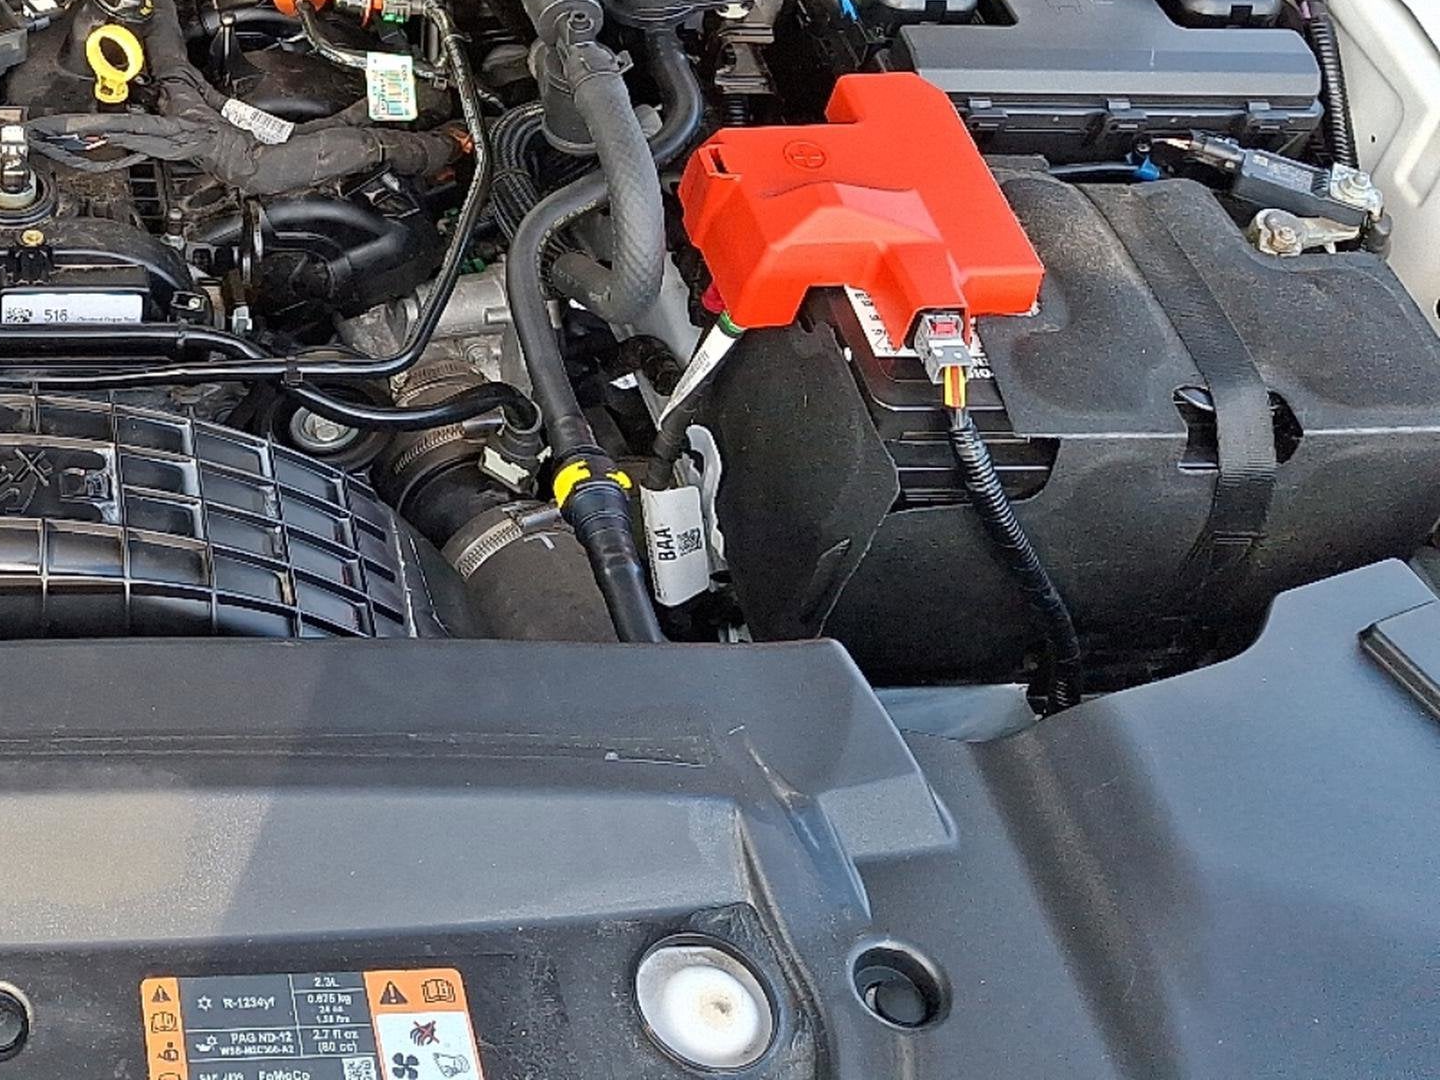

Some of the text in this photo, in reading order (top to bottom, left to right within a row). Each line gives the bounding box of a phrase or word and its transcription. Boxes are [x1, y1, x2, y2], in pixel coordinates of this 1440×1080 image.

[44, 308, 67, 322] 516
[654, 527, 677, 561] BAA
[313, 976, 340, 987] 2.3L
[338, 993, 352, 1005] kg
[230, 1031, 293, 1044] PAG ND-12
[312, 1029, 330, 1040] 2.7
[344, 1030, 359, 1039] oz
[318, 1040, 357, 1053] (80 cc)
[258, 1070, 310, 1080] FoMoCo
